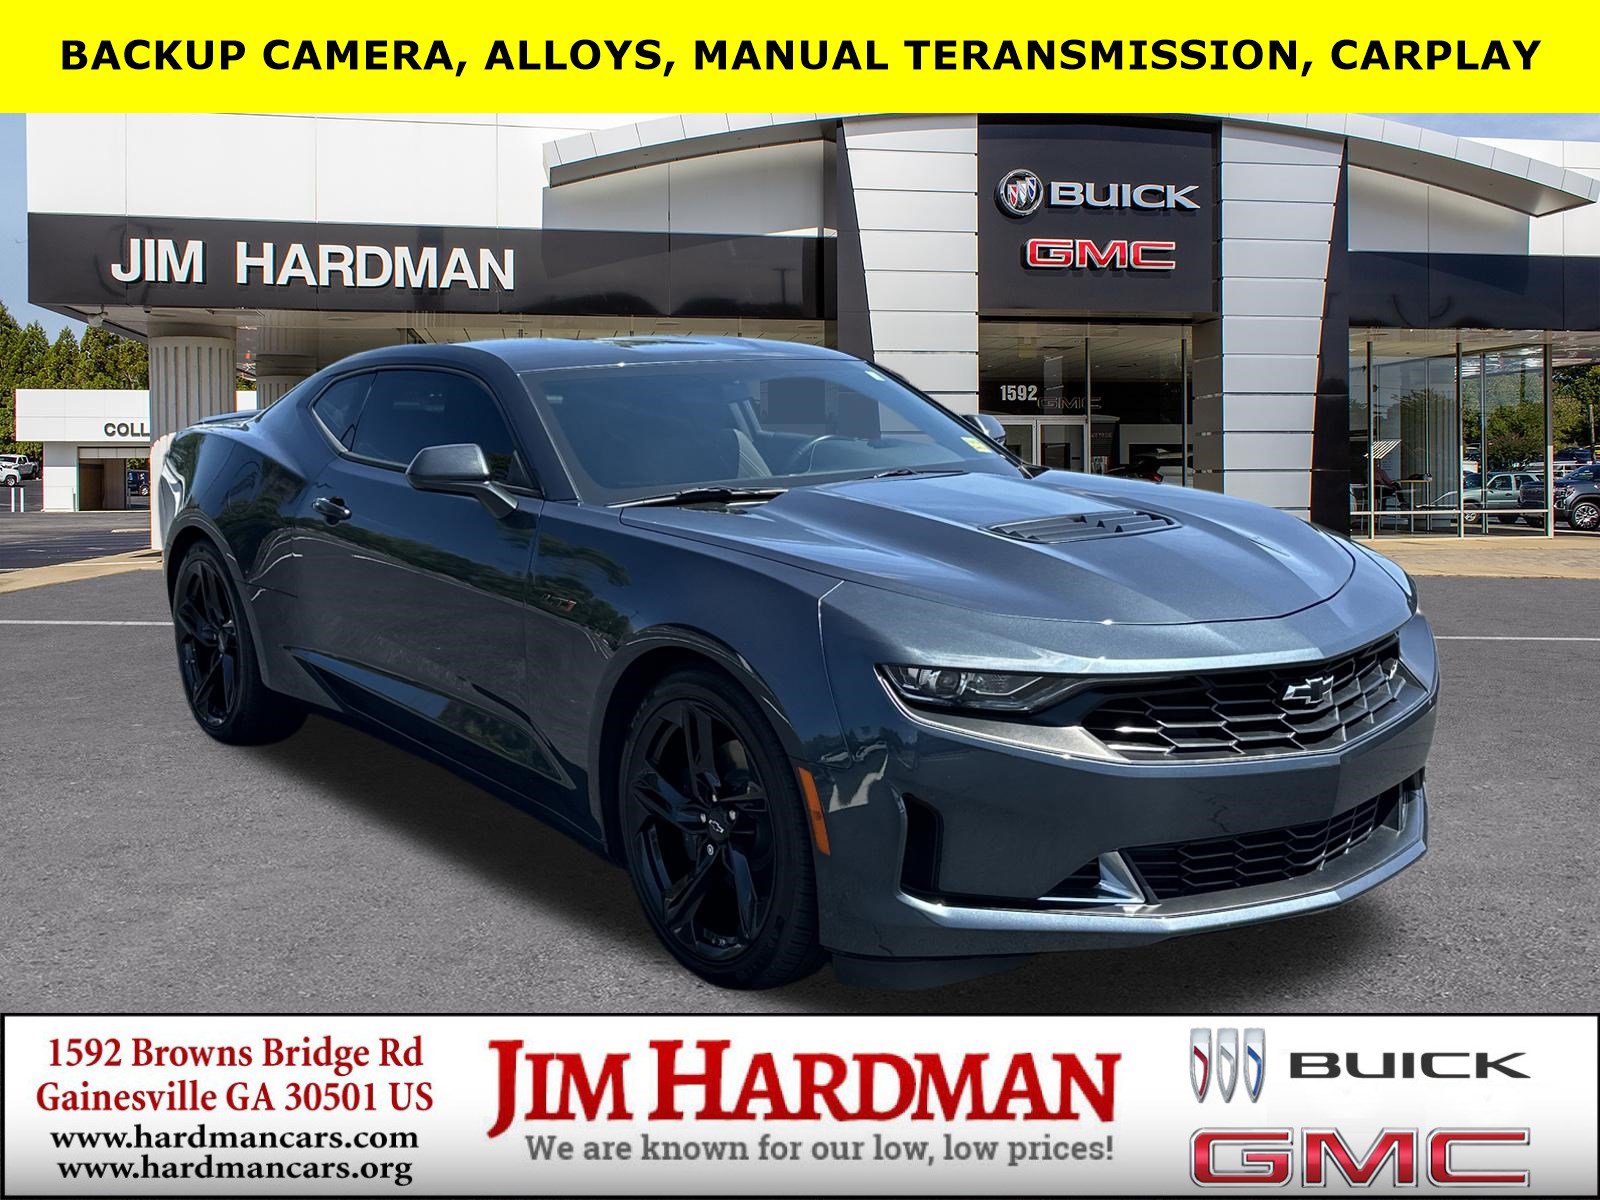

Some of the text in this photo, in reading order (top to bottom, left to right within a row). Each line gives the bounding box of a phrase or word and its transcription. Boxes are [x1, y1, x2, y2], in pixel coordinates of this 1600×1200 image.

[1050, 181, 1201, 209] BUICK
[111, 238, 515, 290] JIM HARDMAN
[1026, 238, 1176, 270] GMC
[1000, 384, 1039, 402] 1592
